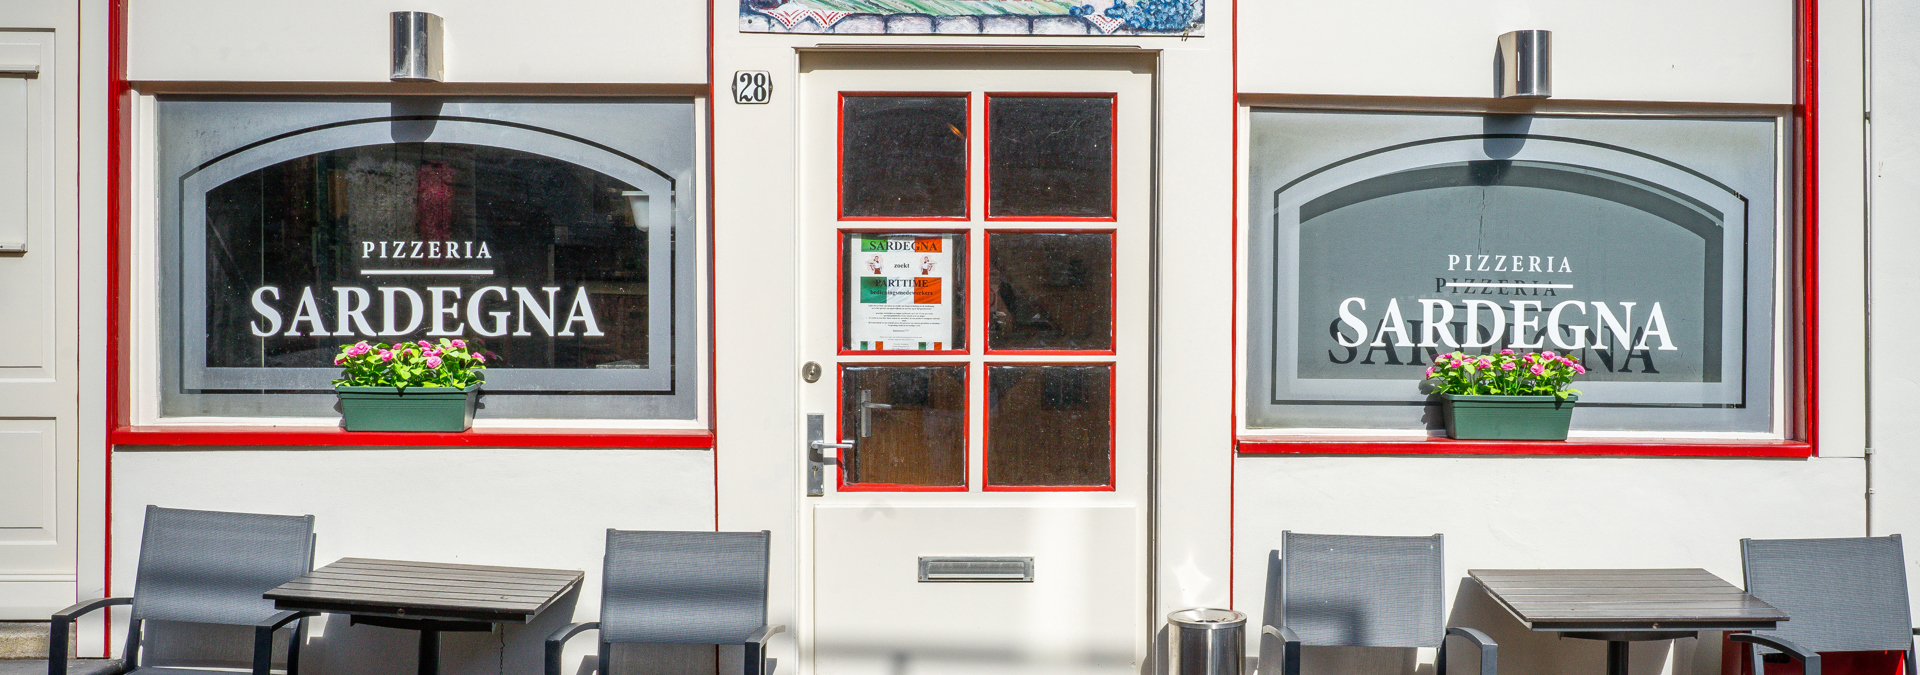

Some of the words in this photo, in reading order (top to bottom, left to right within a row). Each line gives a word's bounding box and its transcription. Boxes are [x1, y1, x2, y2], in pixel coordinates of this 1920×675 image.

[739, 73, 767, 102] 28
[361, 241, 492, 259] PIZZERIA
[869, 240, 937, 251] SARDEGNA
[1448, 254, 1572, 273] PIZZERIA
[875, 279, 929, 288] PARTTIME
[250, 286, 604, 338] SARDEGNA
[1337, 296, 1677, 352] SARDEGNA
